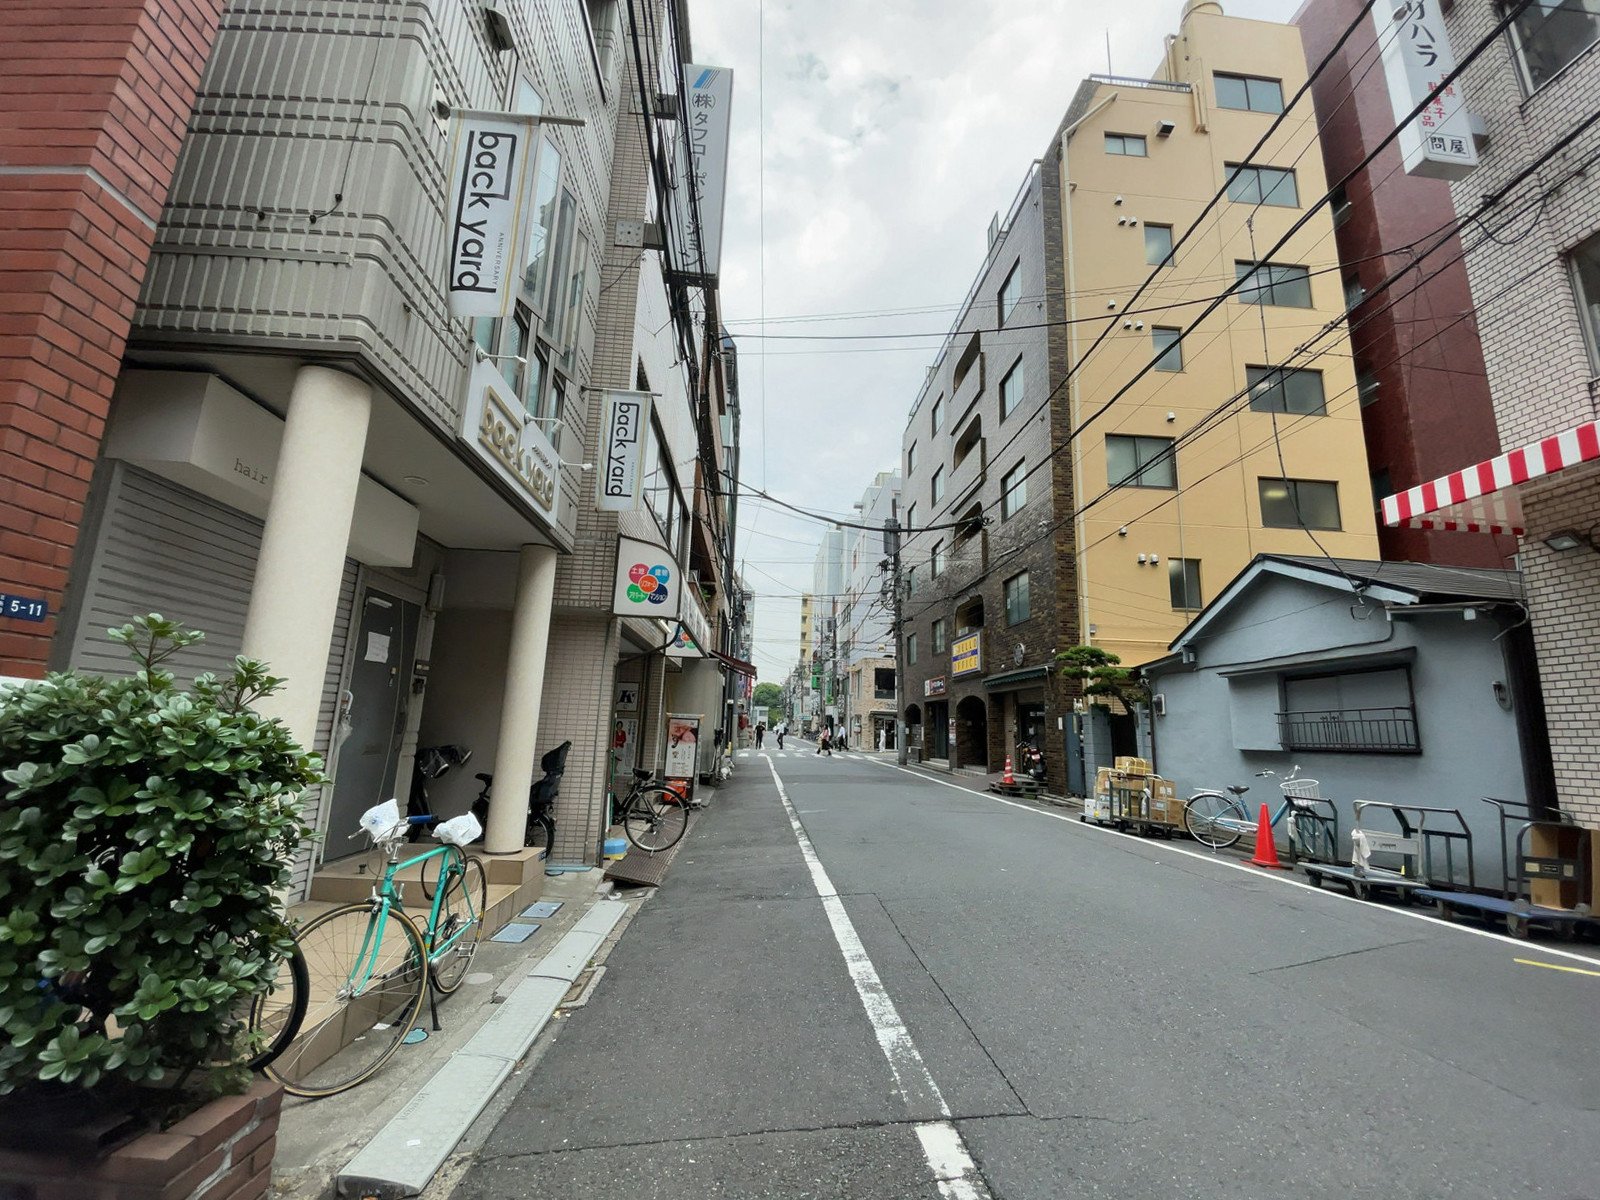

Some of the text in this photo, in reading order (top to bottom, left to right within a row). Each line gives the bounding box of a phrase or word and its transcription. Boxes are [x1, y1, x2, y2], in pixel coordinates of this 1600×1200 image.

[1430, 136, 1467, 155] 問屋
[451, 131, 517, 293] back yard
[494, 232, 505, 287] ANNIVERSARY
[233, 457, 269, 485] hair
[480, 385, 525, 471] back
[525, 455, 557, 512] yard
[605, 402, 640, 498] back yard
[10, 599, 42, 617] 5-11
